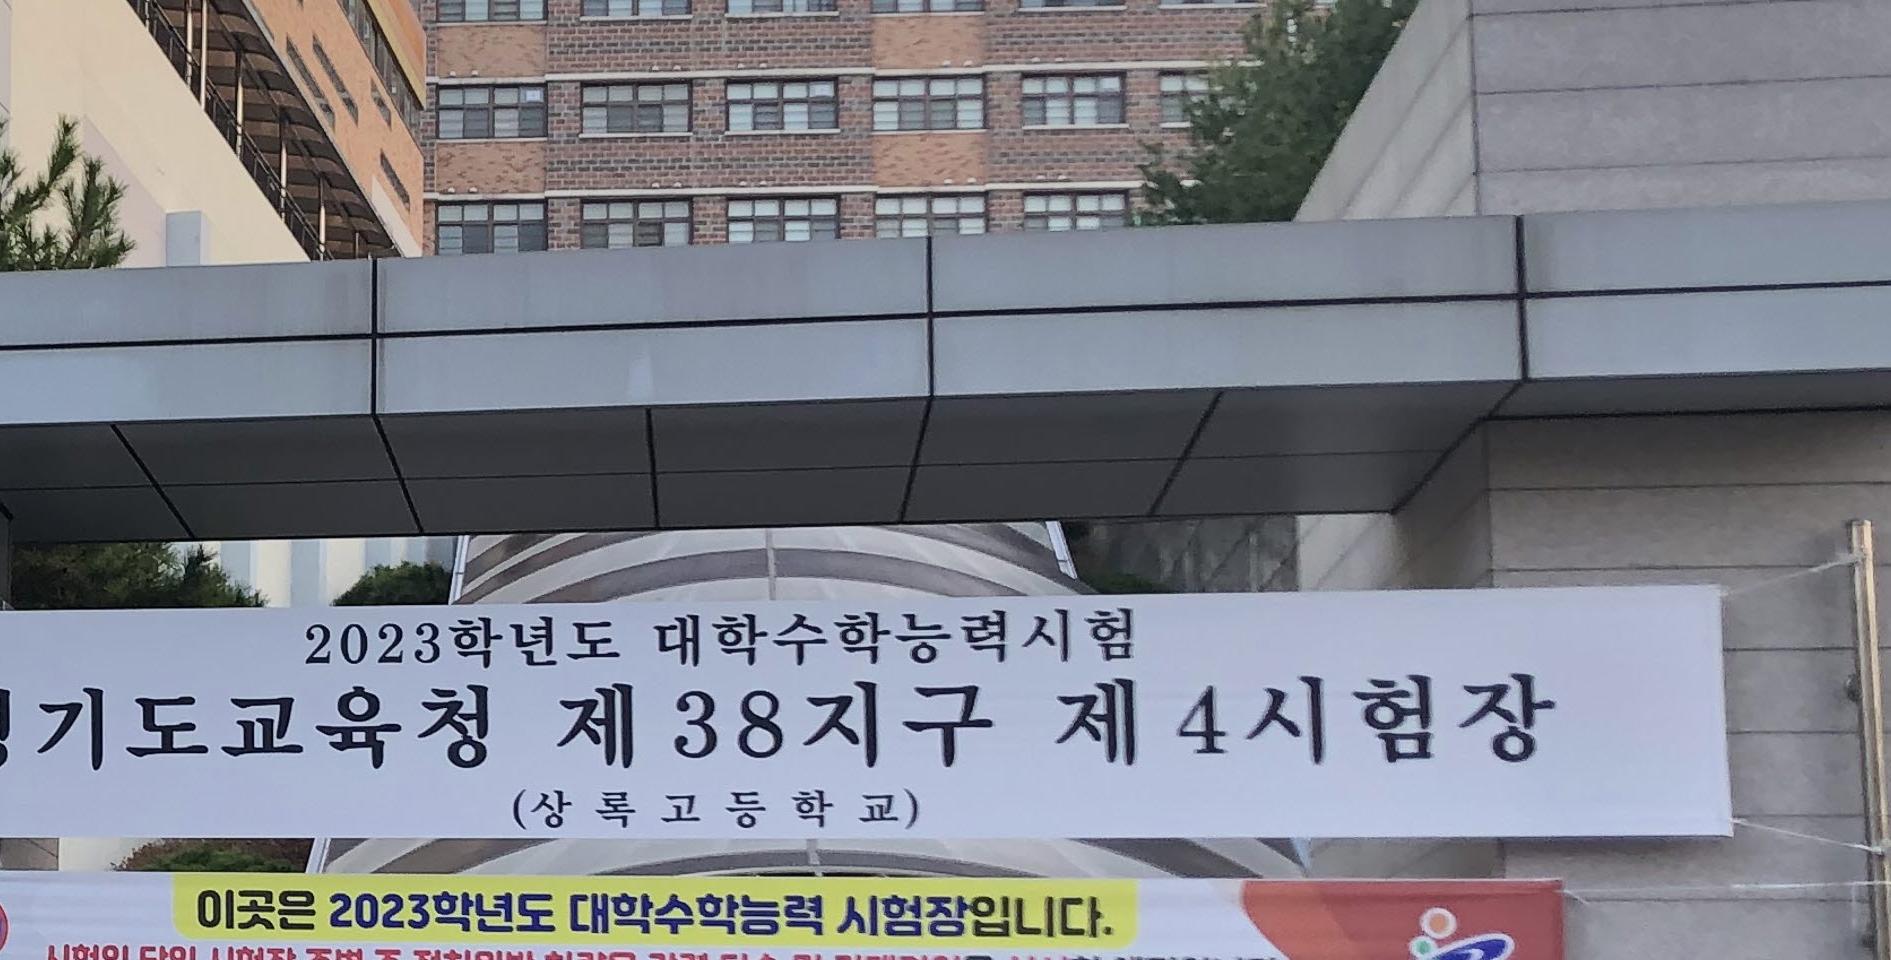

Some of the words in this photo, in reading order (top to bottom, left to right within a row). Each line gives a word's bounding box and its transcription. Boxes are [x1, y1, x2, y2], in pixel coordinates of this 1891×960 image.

[304, 614, 622, 669] 2023학년도
[654, 606, 1137, 665] 대학수학능력시험
[197, 889, 316, 931] 이곳은
[329, 892, 557, 934] 2023학년도
[570, 892, 824, 937] 대학수학능력
[838, 894, 1114, 938] 시험장입니다.
